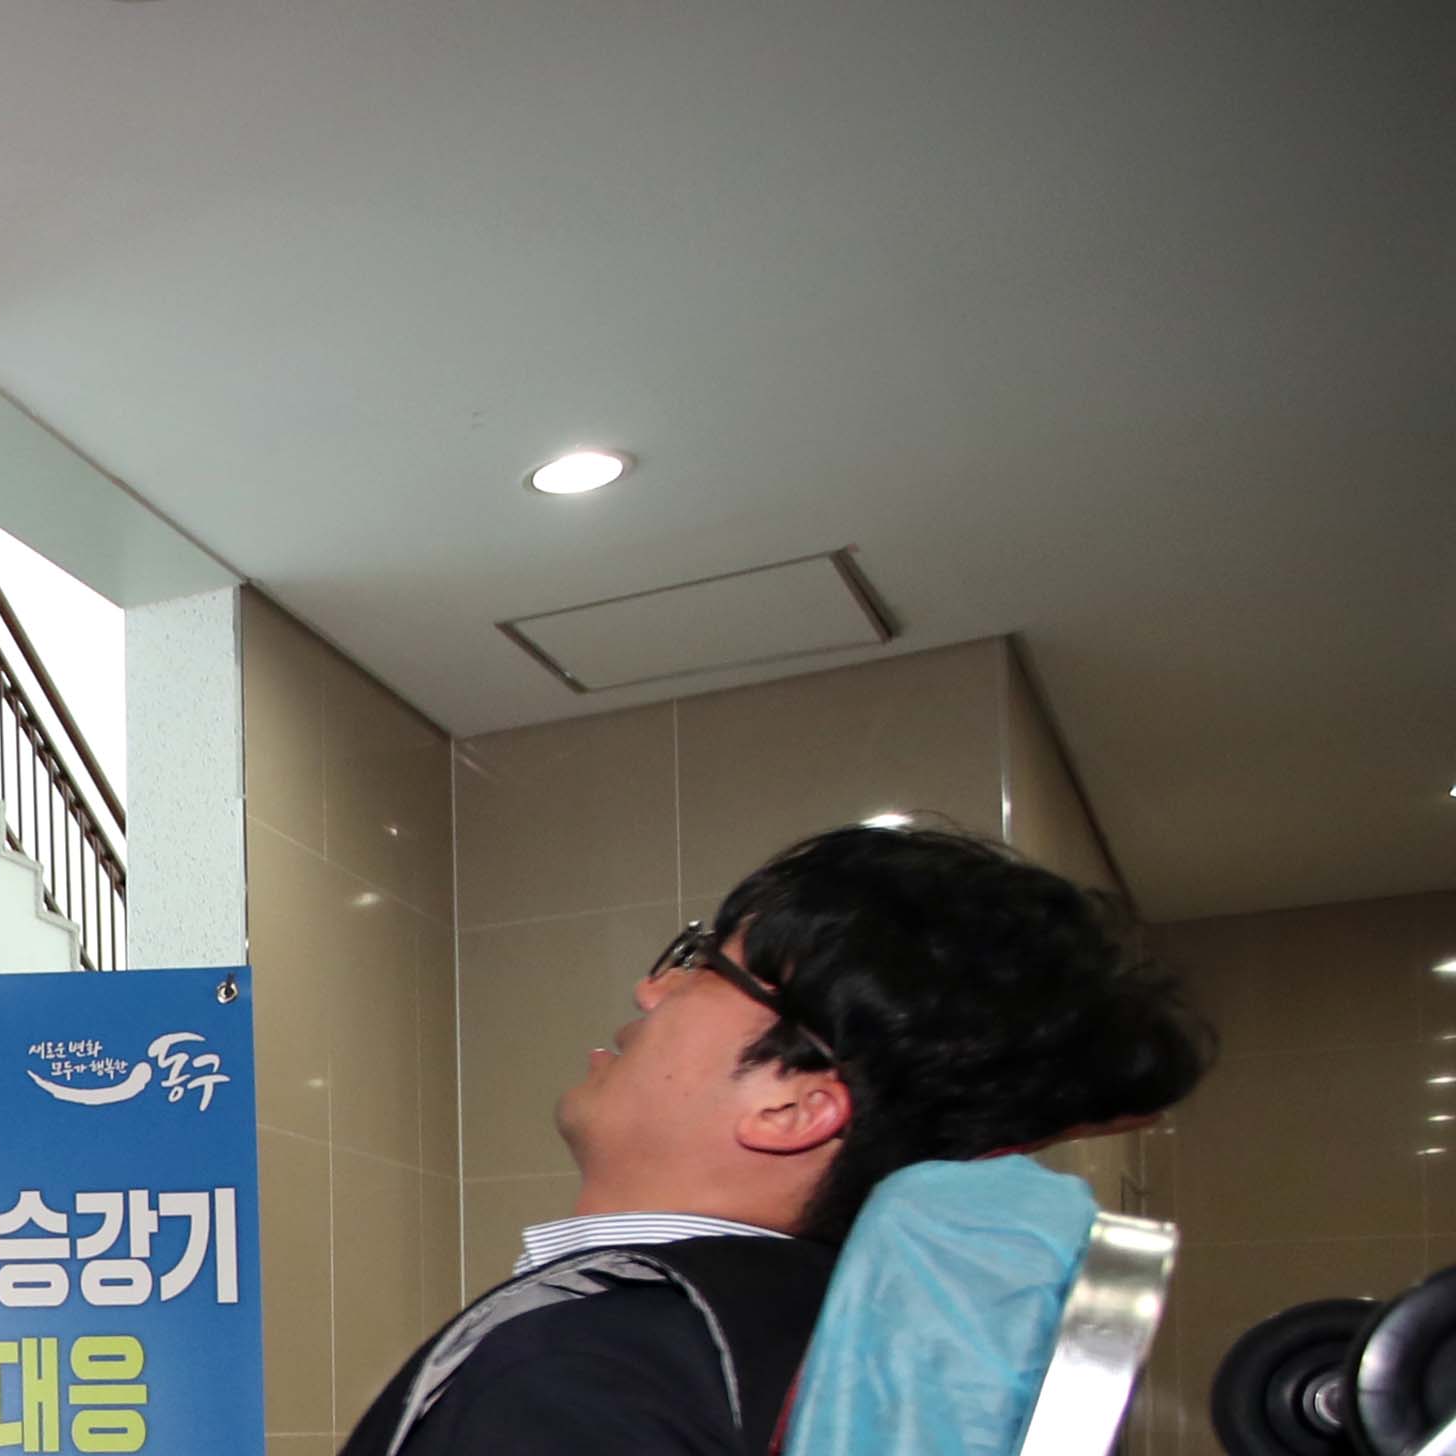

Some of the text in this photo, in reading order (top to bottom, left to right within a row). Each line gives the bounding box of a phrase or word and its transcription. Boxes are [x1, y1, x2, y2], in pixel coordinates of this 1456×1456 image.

[28, 1039, 103, 1059] 새로운 변화
[50, 1057, 128, 1080] 모두가 행복한
[147, 1031, 231, 1112] 동구
